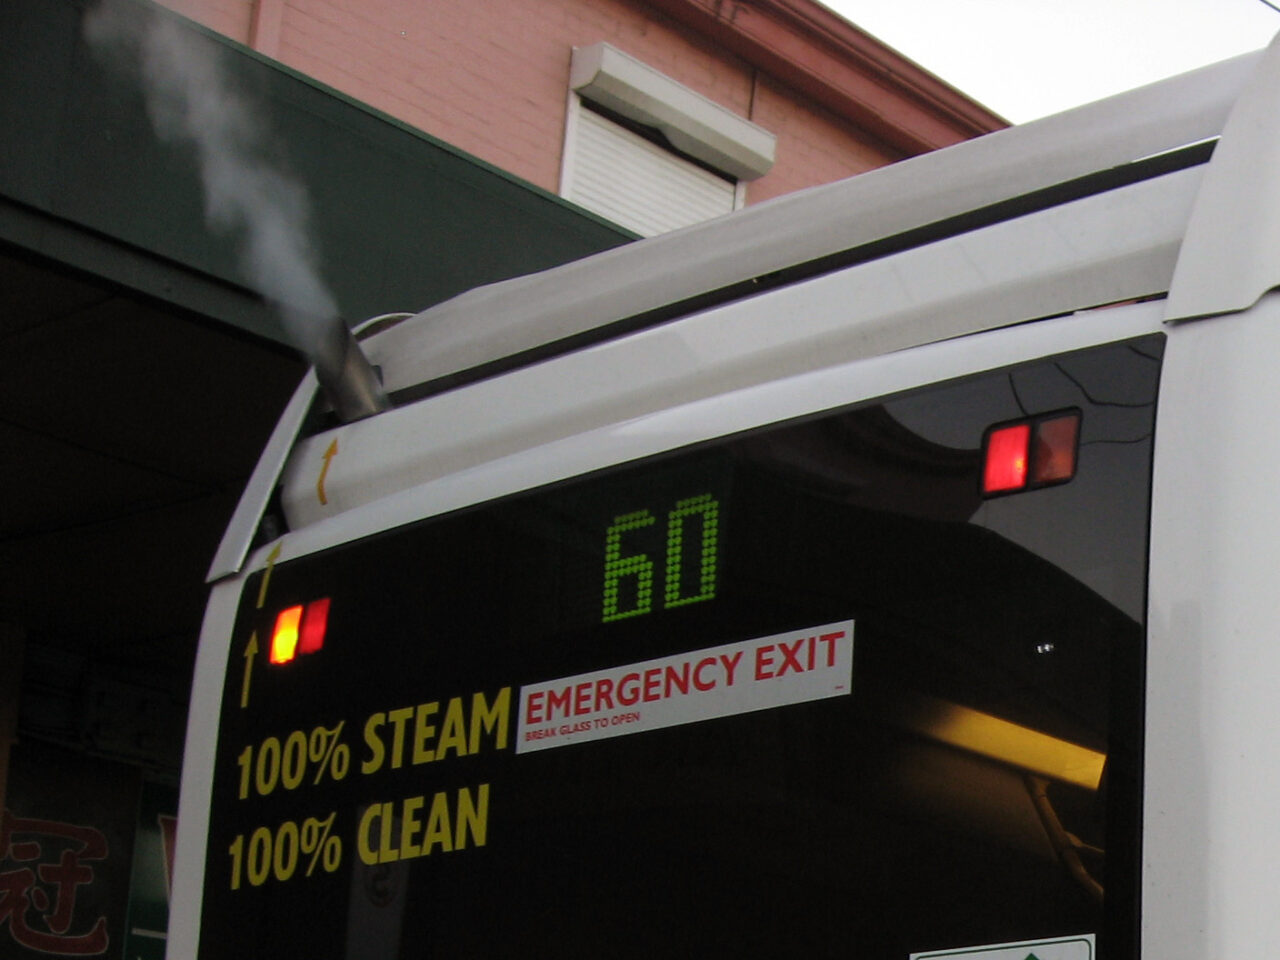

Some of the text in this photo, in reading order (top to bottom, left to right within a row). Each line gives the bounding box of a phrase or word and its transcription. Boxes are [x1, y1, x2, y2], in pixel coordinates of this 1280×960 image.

[602, 493, 719, 622] 60
[524, 629, 847, 726] EMERGENCY EXIT
[524, 711, 641, 743] BREAK GLASS TO OPEN
[237, 686, 512, 801] 100% STEAM
[228, 811, 343, 891] 100%
[357, 783, 491, 867] CLEAN
